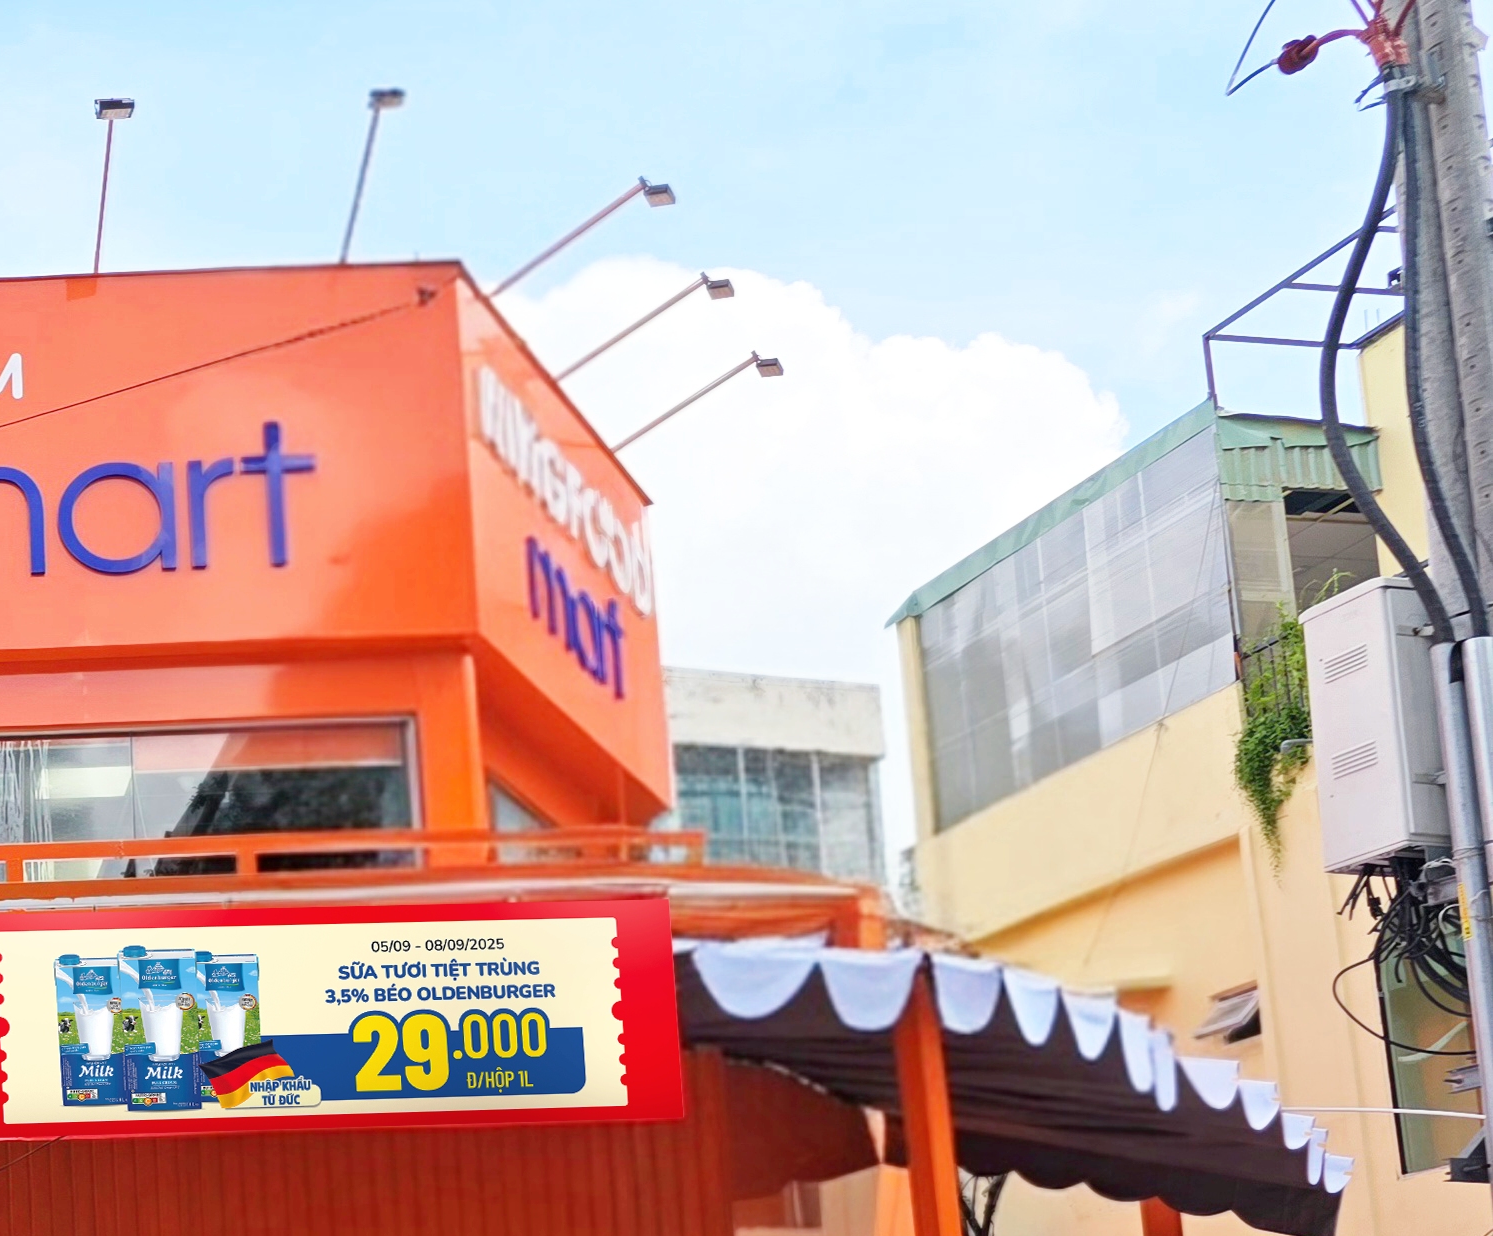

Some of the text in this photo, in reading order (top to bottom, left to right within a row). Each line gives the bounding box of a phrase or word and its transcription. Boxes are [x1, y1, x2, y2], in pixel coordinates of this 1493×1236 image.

[371, 938, 505, 953] 05/09 08/09/2025
[338, 957, 541, 981] SỮA TƯƠI TIỆT TRÙNG
[325, 984, 556, 1006] 3,5% BÉO OLDENBURGER
[78, 1064, 115, 1078] Milk
[144, 1065, 184, 1080] Milk
[249, 1076, 311, 1094] NHẬP KHẨU
[466, 1067, 534, 1093] Đ/HỘP 1L
[278, 1092, 301, 1106] ĐỨC
